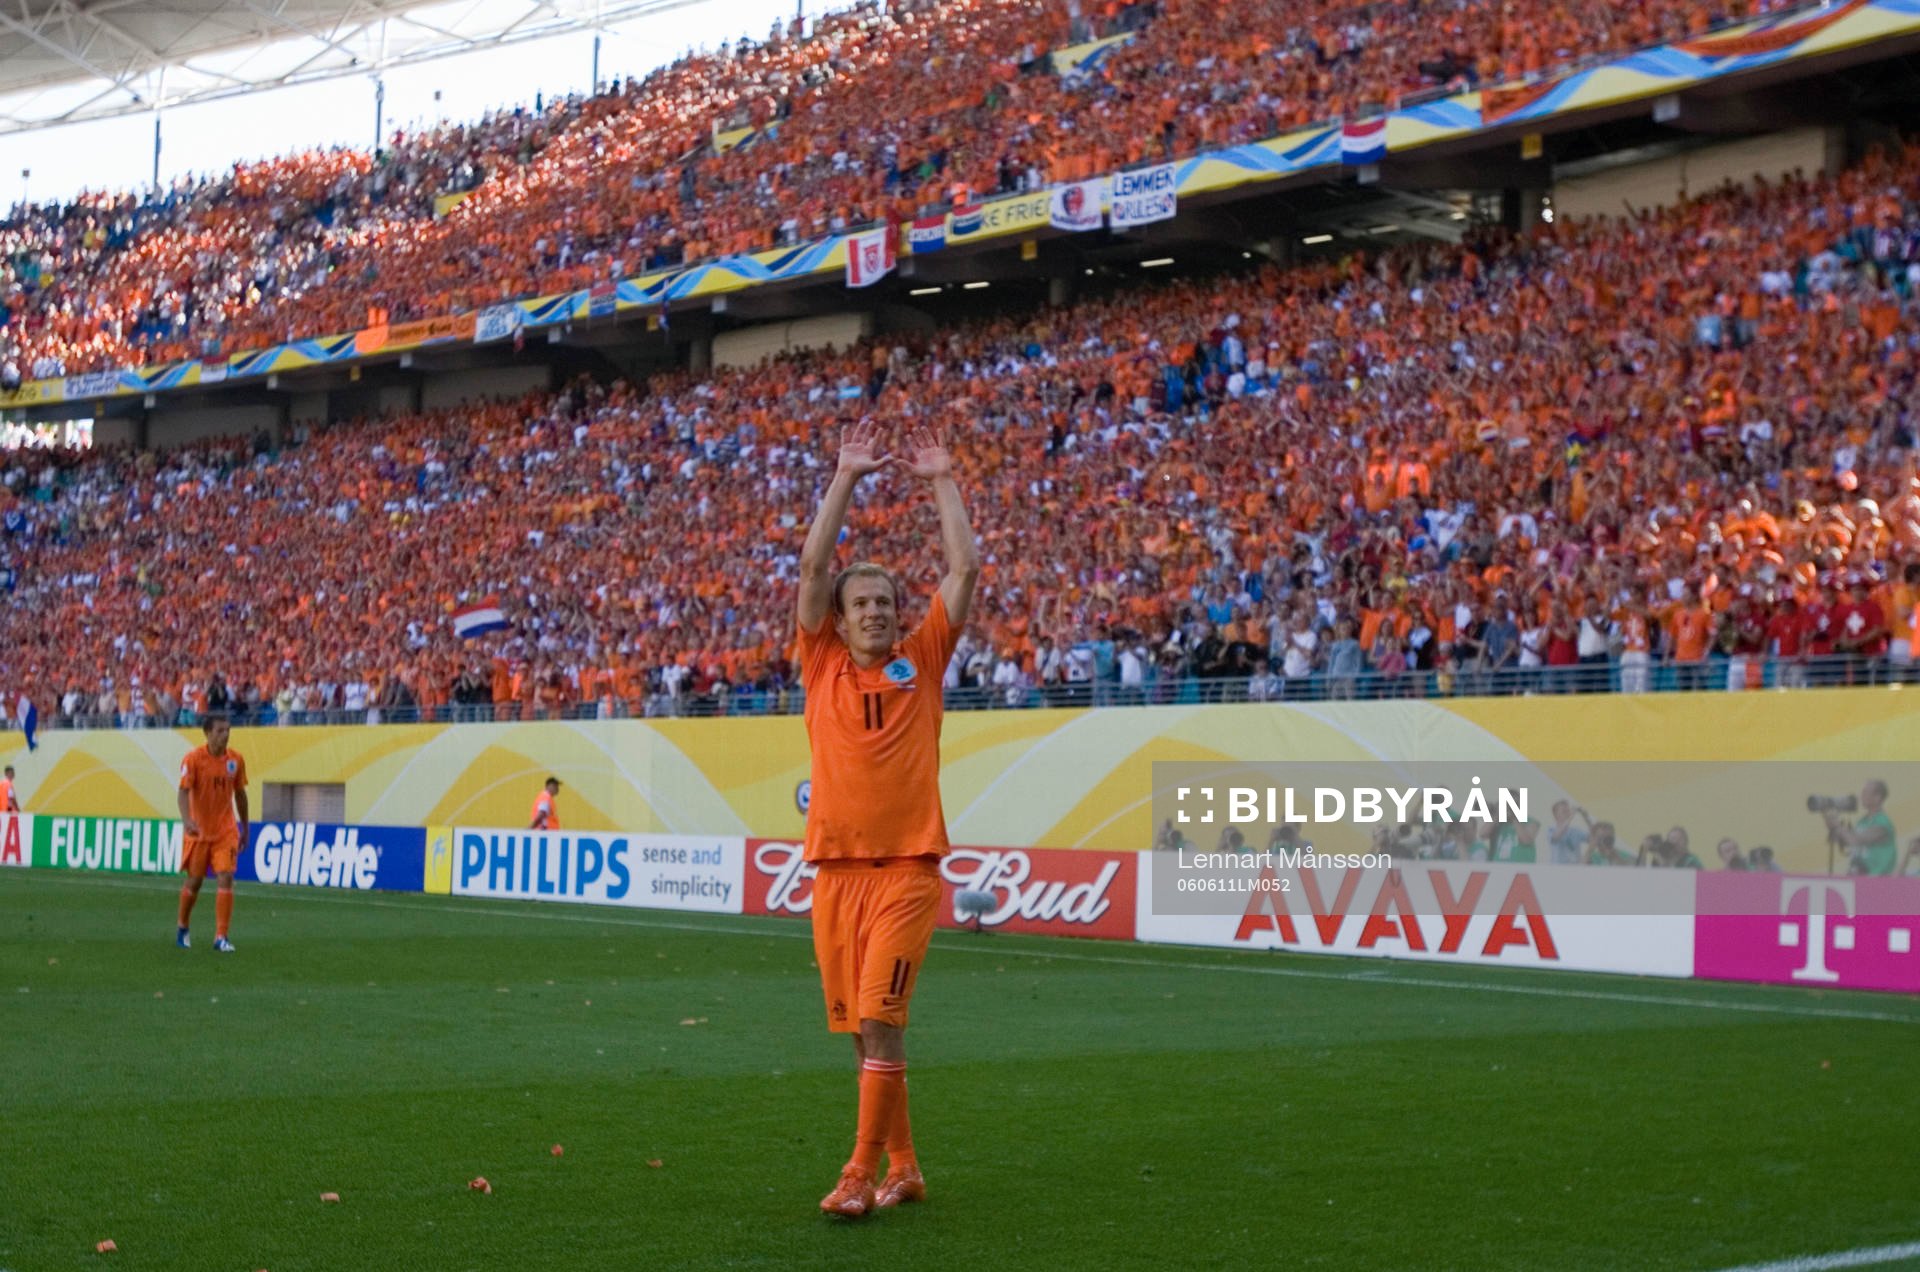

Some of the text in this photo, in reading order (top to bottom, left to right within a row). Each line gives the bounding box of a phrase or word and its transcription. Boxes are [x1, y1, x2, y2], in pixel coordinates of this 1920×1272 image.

[863, 693, 883, 730] 11
[50, 818, 184, 874] FUJIFILM
[254, 822, 378, 890] Gillette
[461, 834, 631, 899] PHILIPS
[642, 845, 722, 865] sense and
[651, 876, 732, 904] simplicity
[940, 849, 1121, 925] Bud
[1233, 866, 1560, 960] AVAYA
[890, 959, 911, 997] 11
